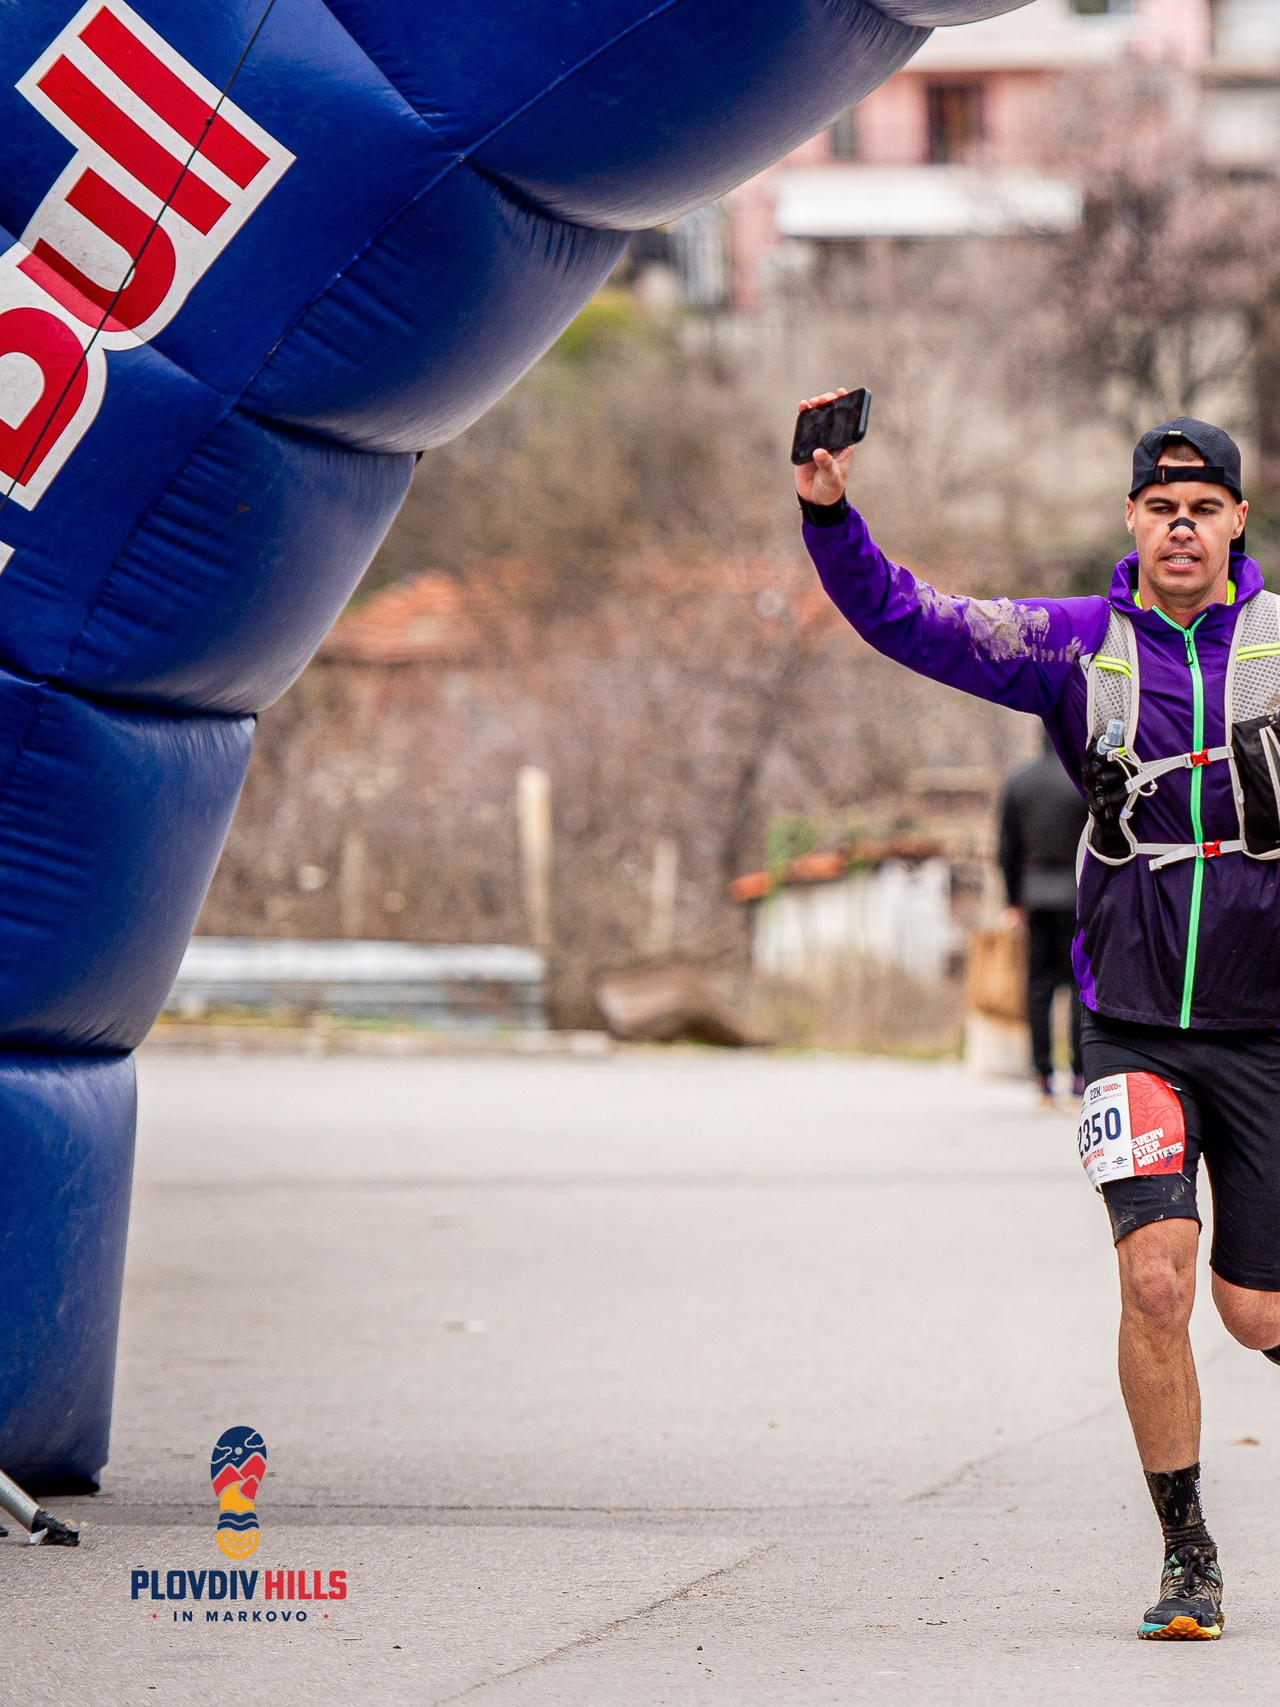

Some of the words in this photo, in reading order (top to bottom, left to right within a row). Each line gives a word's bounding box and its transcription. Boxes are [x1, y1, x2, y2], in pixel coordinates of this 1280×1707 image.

[1077, 1107, 1122, 1158] 2350
[1131, 1127, 1164, 1149] EVERY
[1132, 1140, 1161, 1158] STEP
[1136, 1141, 1184, 1168] MATTERS
